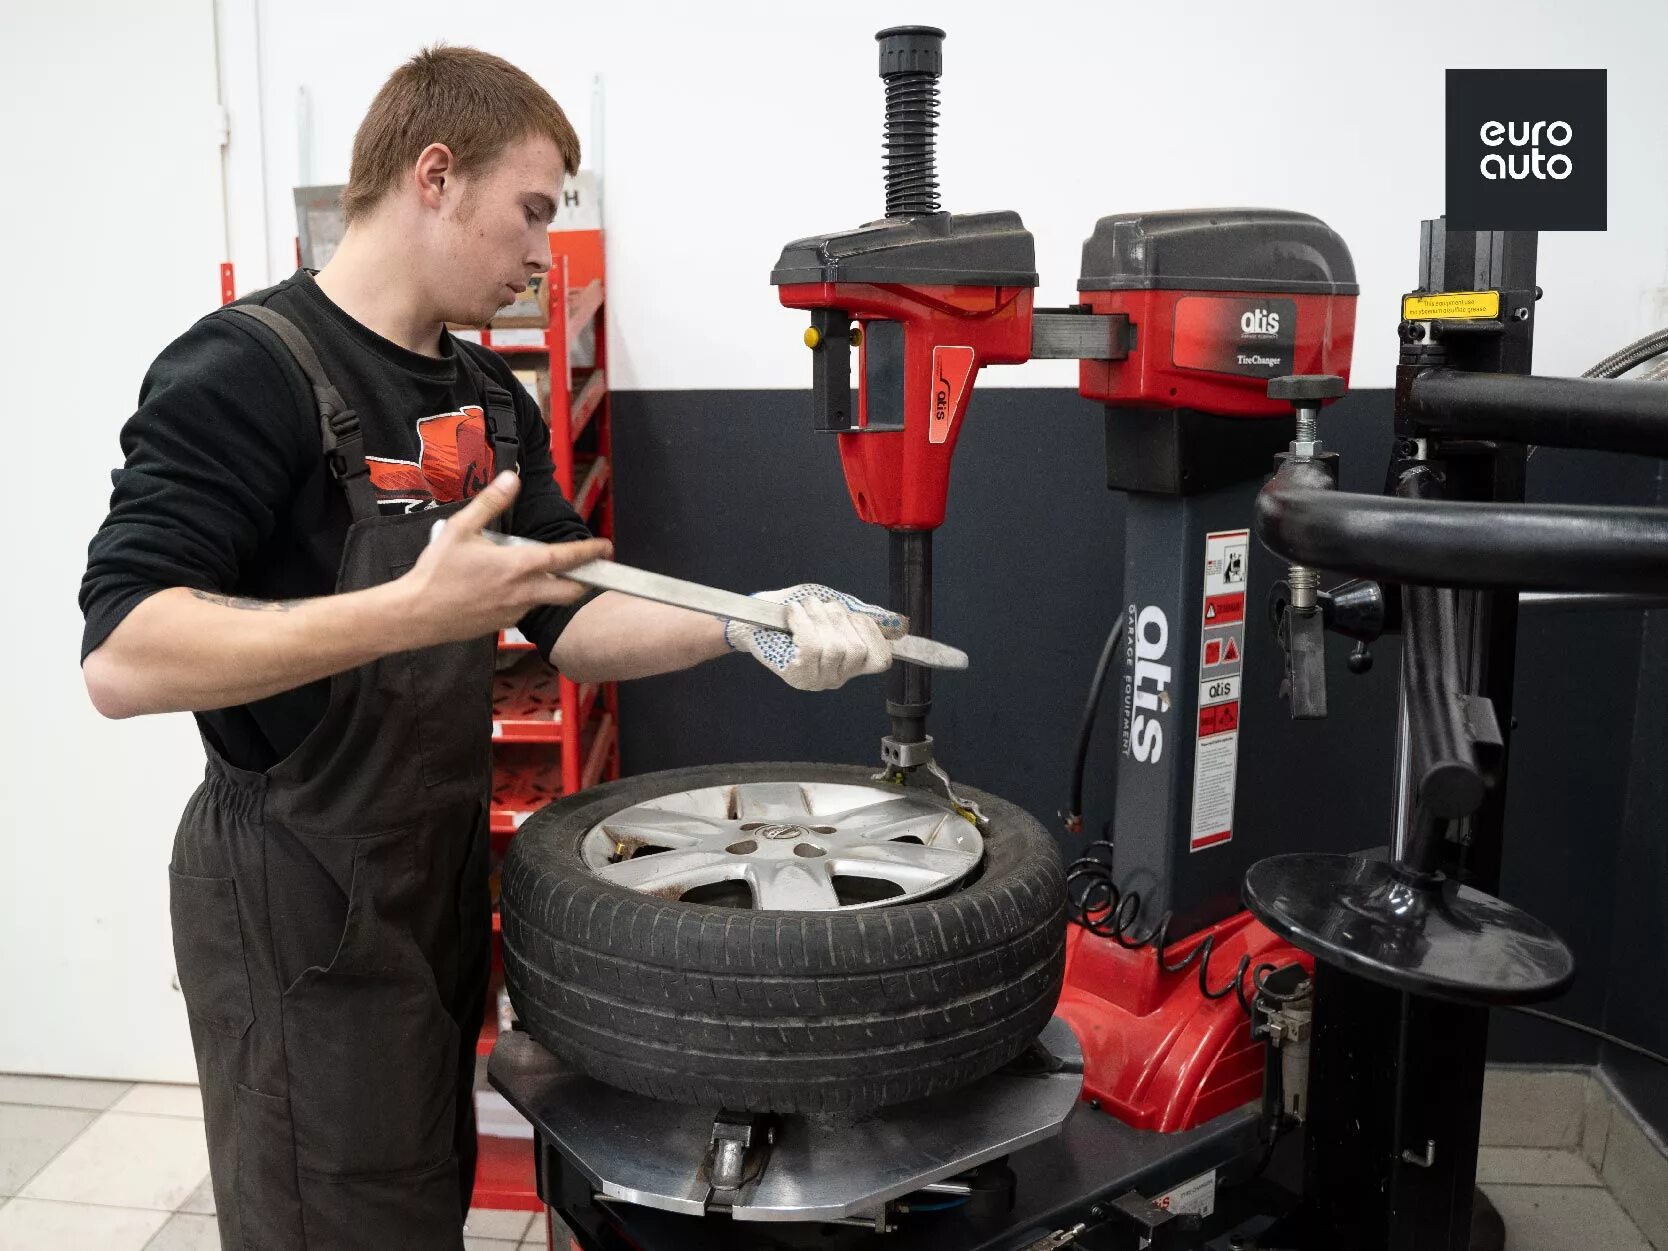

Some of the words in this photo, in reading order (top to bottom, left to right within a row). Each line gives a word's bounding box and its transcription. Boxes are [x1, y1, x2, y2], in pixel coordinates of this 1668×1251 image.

[1241, 309, 1279, 334] atis
[1237, 355, 1281, 367] TireChanger
[936, 391, 947, 421] atis
[1127, 604, 1136, 666] GARAGE
[1132, 605, 1171, 764] atis
[1209, 683, 1231, 698] atis
[1122, 675, 1132, 758] EQUIPMENT
